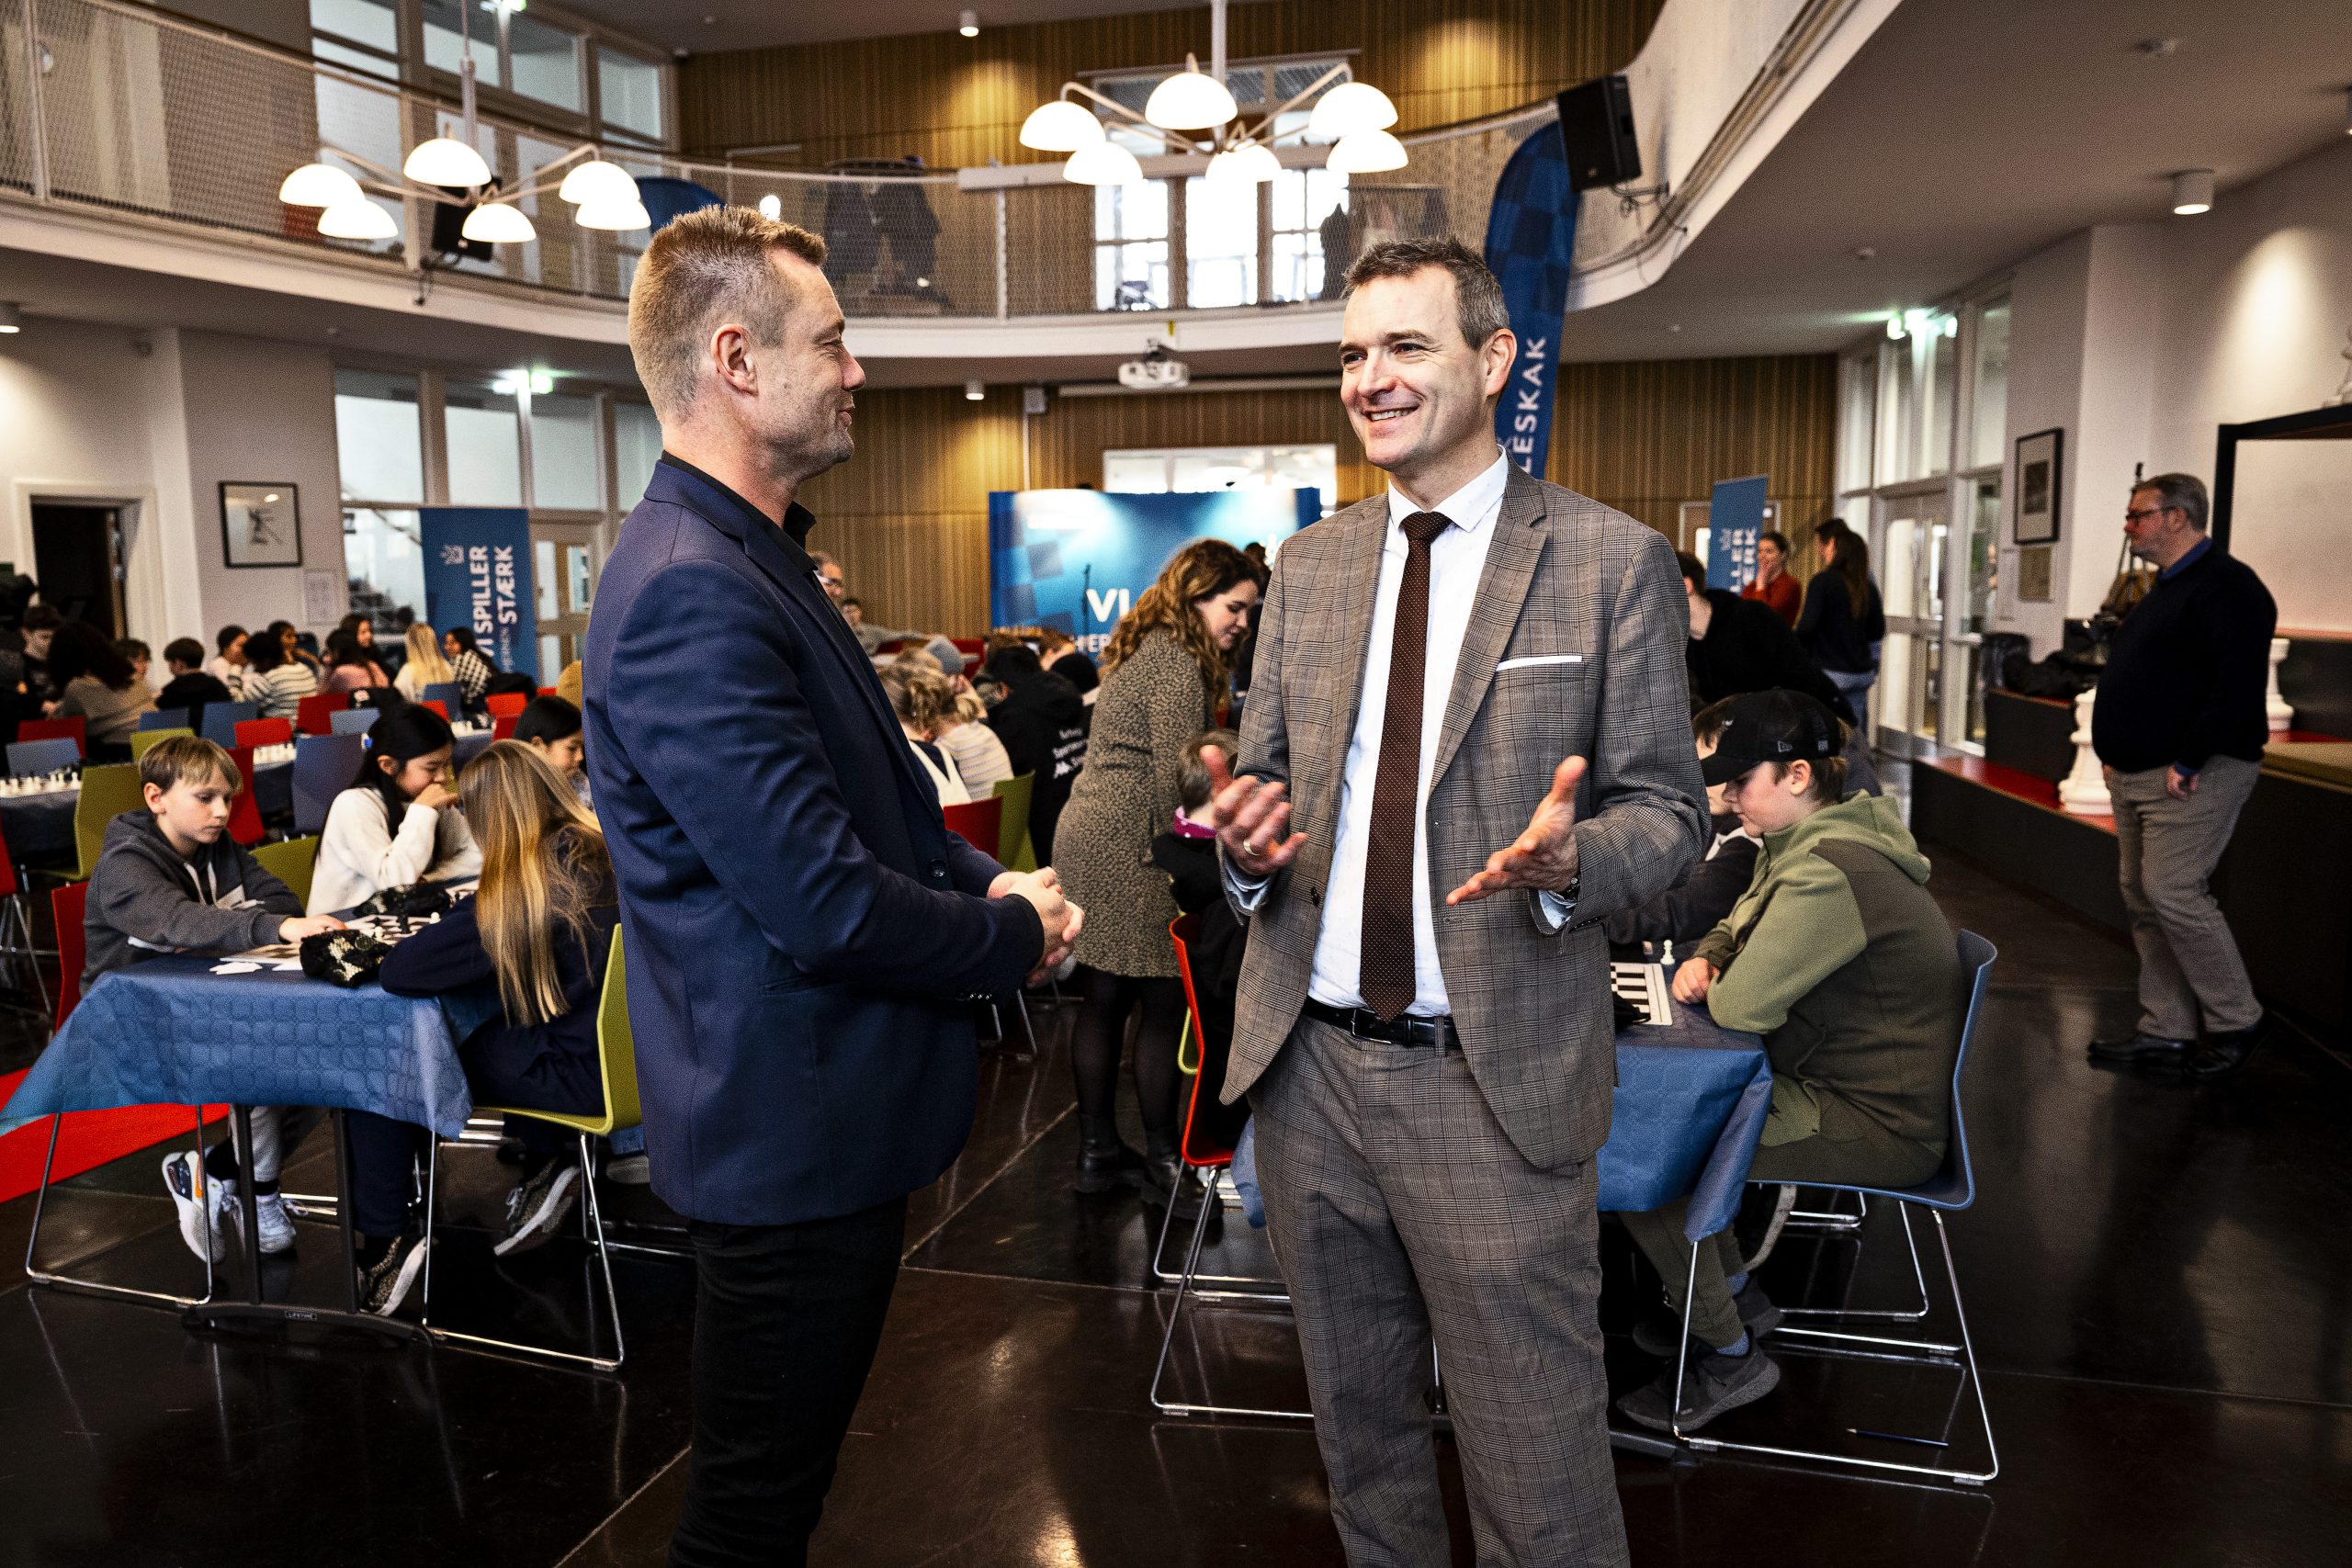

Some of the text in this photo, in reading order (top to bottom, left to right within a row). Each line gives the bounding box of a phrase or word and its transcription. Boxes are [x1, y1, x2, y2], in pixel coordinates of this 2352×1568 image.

[469, 546, 493, 634] SPILLER
[493, 546, 517, 626] STÆRK
[1085, 588, 1130, 623] VI
